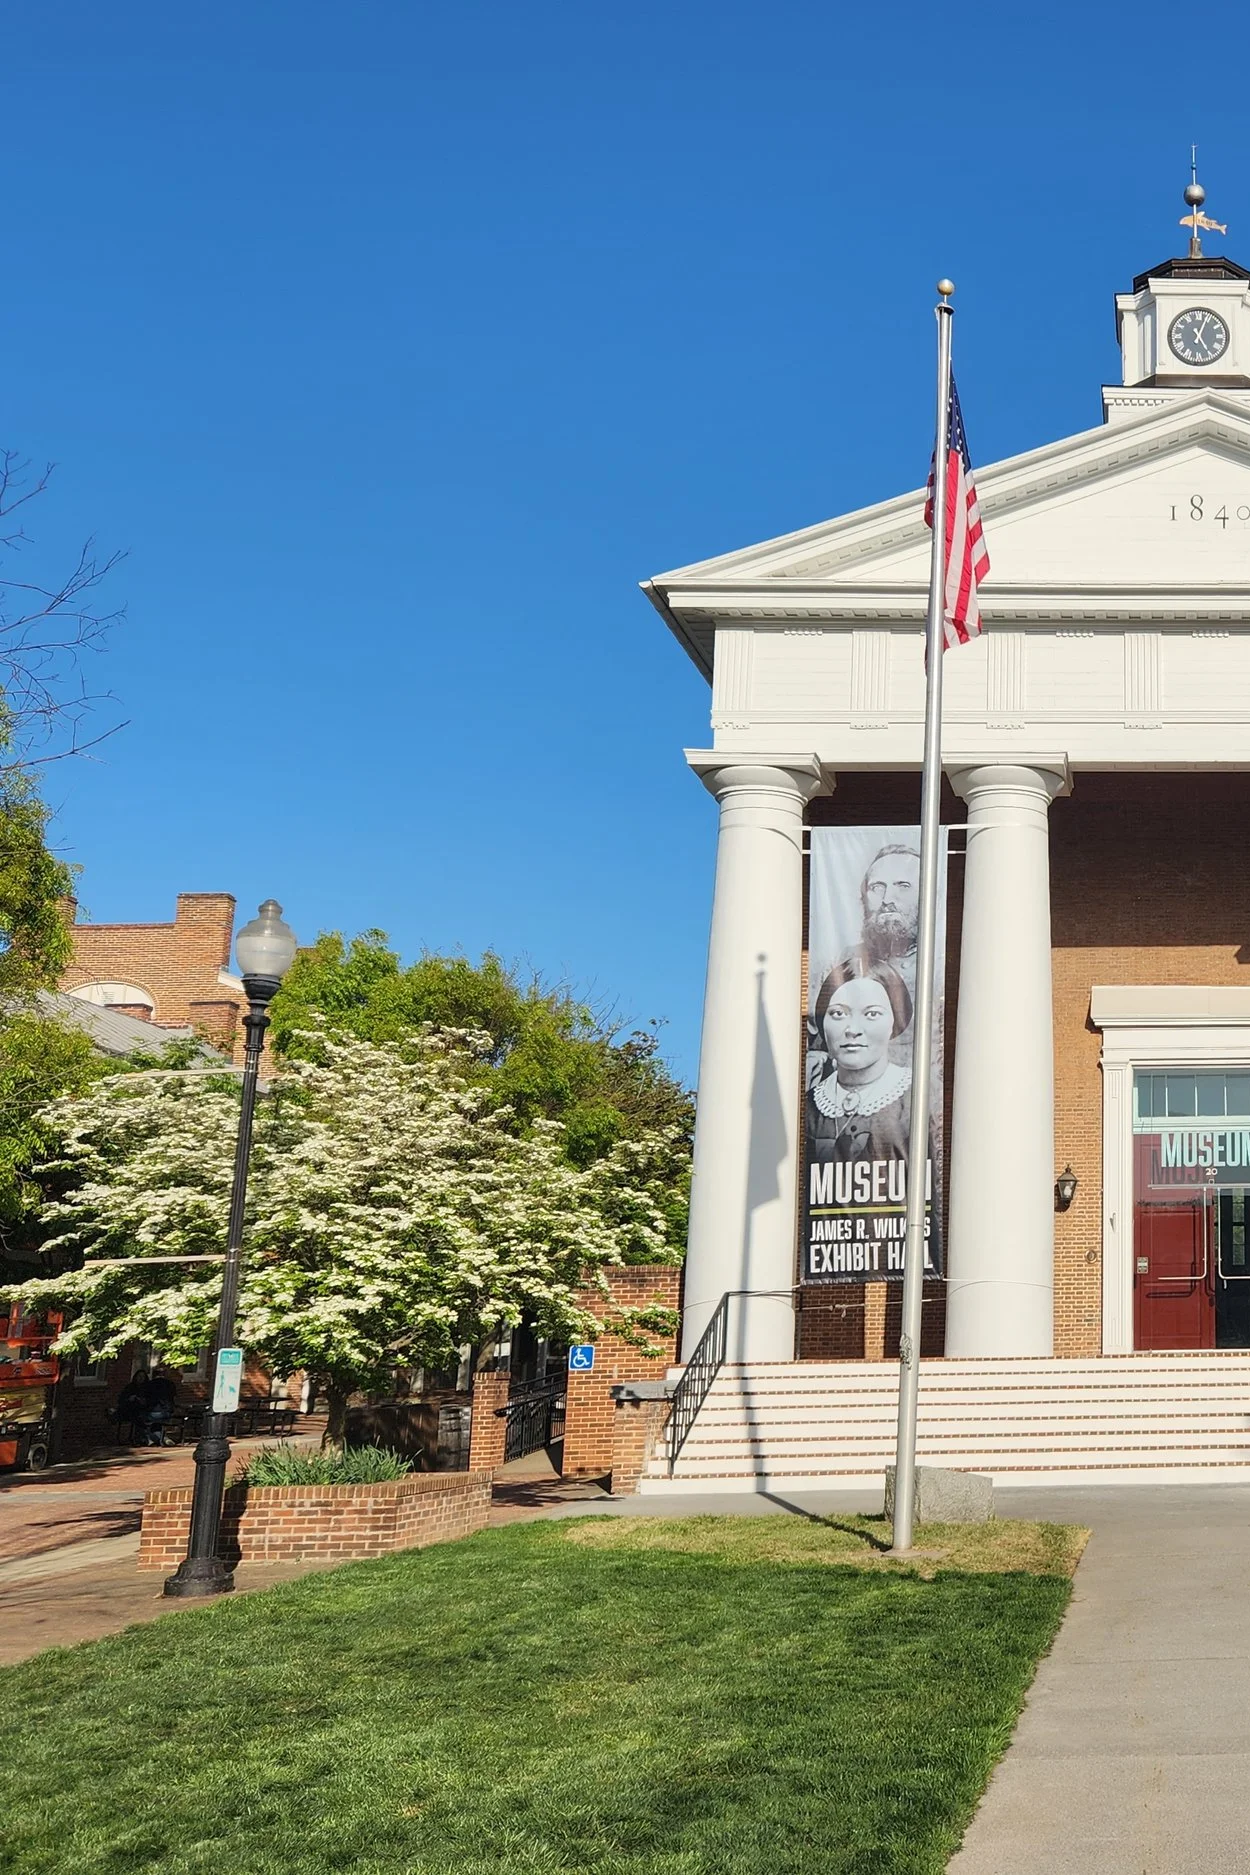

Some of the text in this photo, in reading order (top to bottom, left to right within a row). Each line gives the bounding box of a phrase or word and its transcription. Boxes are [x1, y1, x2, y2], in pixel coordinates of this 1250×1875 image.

[1169, 494, 1250, 529] 1840
[810, 1159, 932, 1204] MUSEU
[1205, 1168, 1218, 1176] 20
[809, 1217, 931, 1242] JAMES R. WILKS
[810, 1240, 934, 1274] EXHIBIT HL
